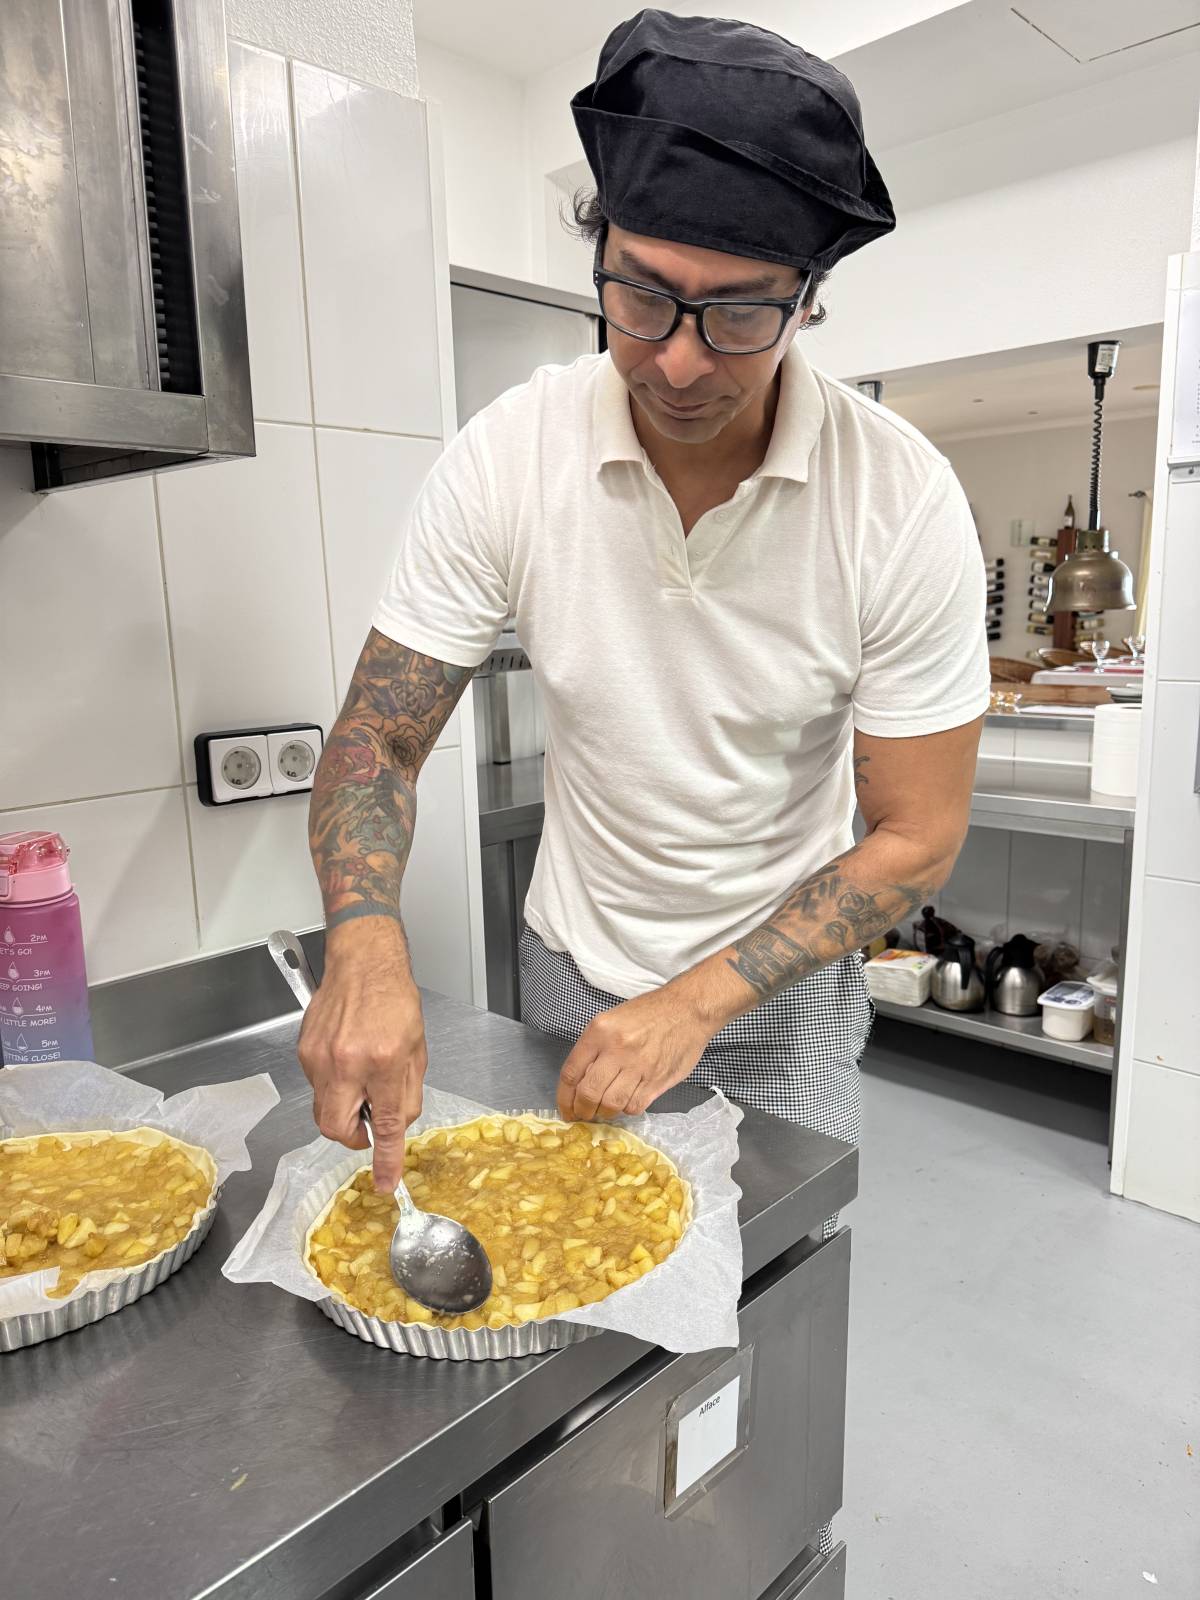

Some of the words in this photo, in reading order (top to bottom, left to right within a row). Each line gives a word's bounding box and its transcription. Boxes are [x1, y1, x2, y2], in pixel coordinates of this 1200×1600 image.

[12, 983, 43, 992] GOING!
[30, 1016, 57, 1027] MORE!
[31, 1051, 61, 1062] CLOSE!
[698, 1395, 721, 1417] Alface
